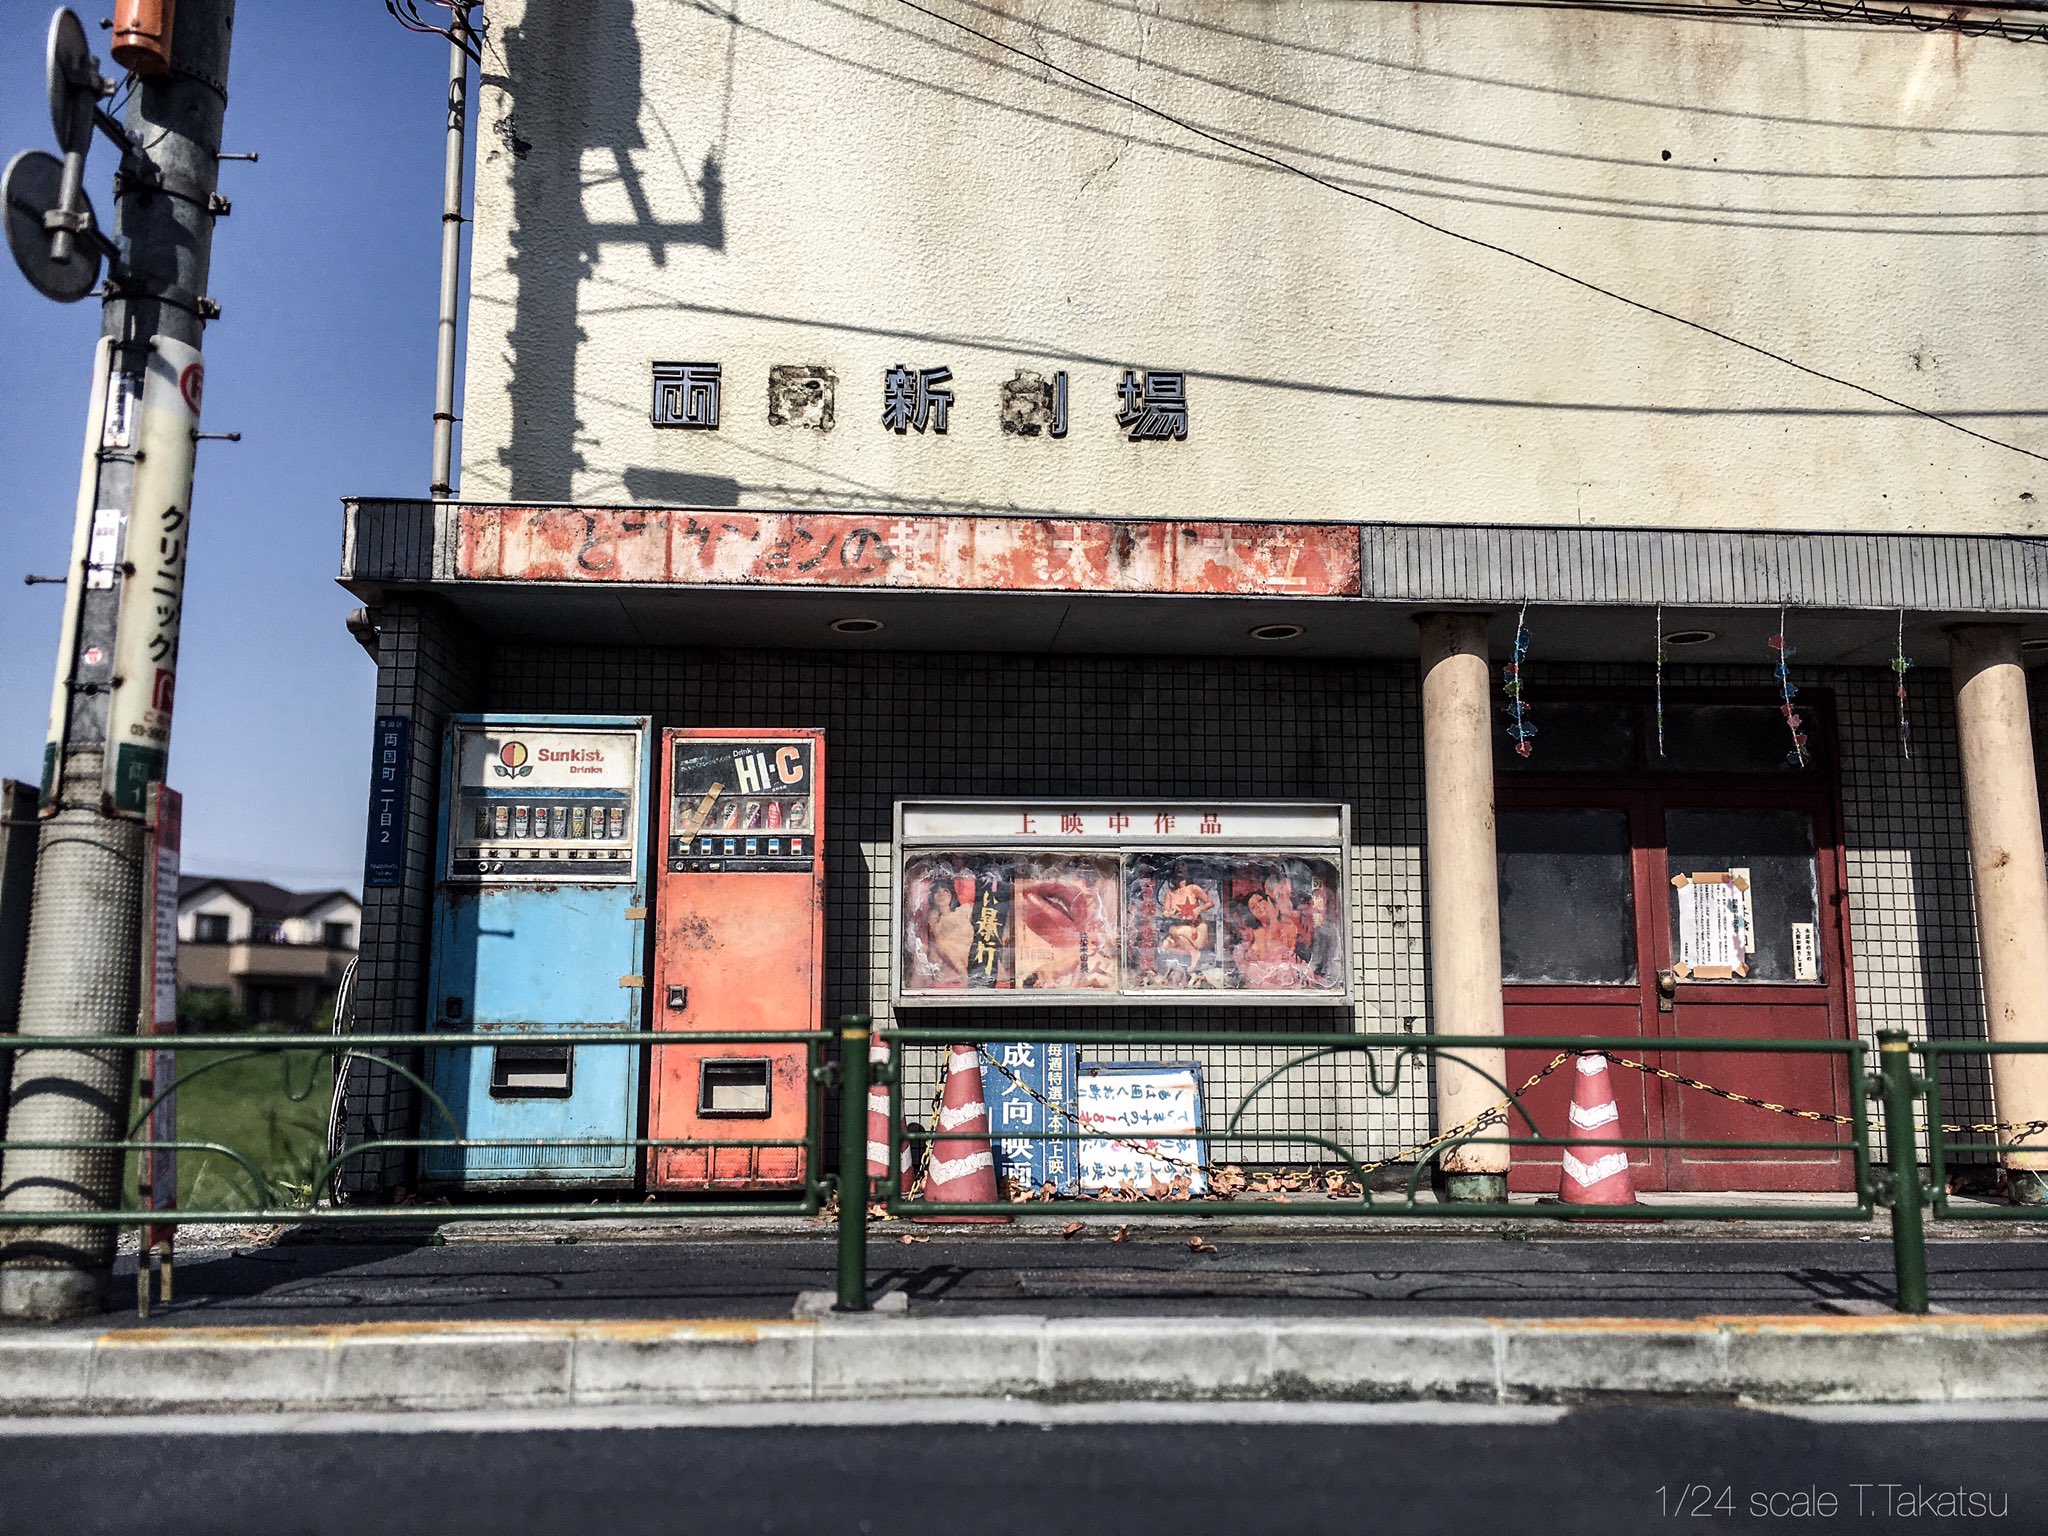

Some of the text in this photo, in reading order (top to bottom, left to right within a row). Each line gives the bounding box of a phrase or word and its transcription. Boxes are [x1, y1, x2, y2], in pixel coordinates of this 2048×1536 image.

[651, 360, 1188, 440] 両新場
[149, 505, 186, 662] クリニック
[537, 748, 605, 762] Sunkist
[733, 748, 753, 758] Drink
[1015, 812, 1222, 835] 上映中作品
